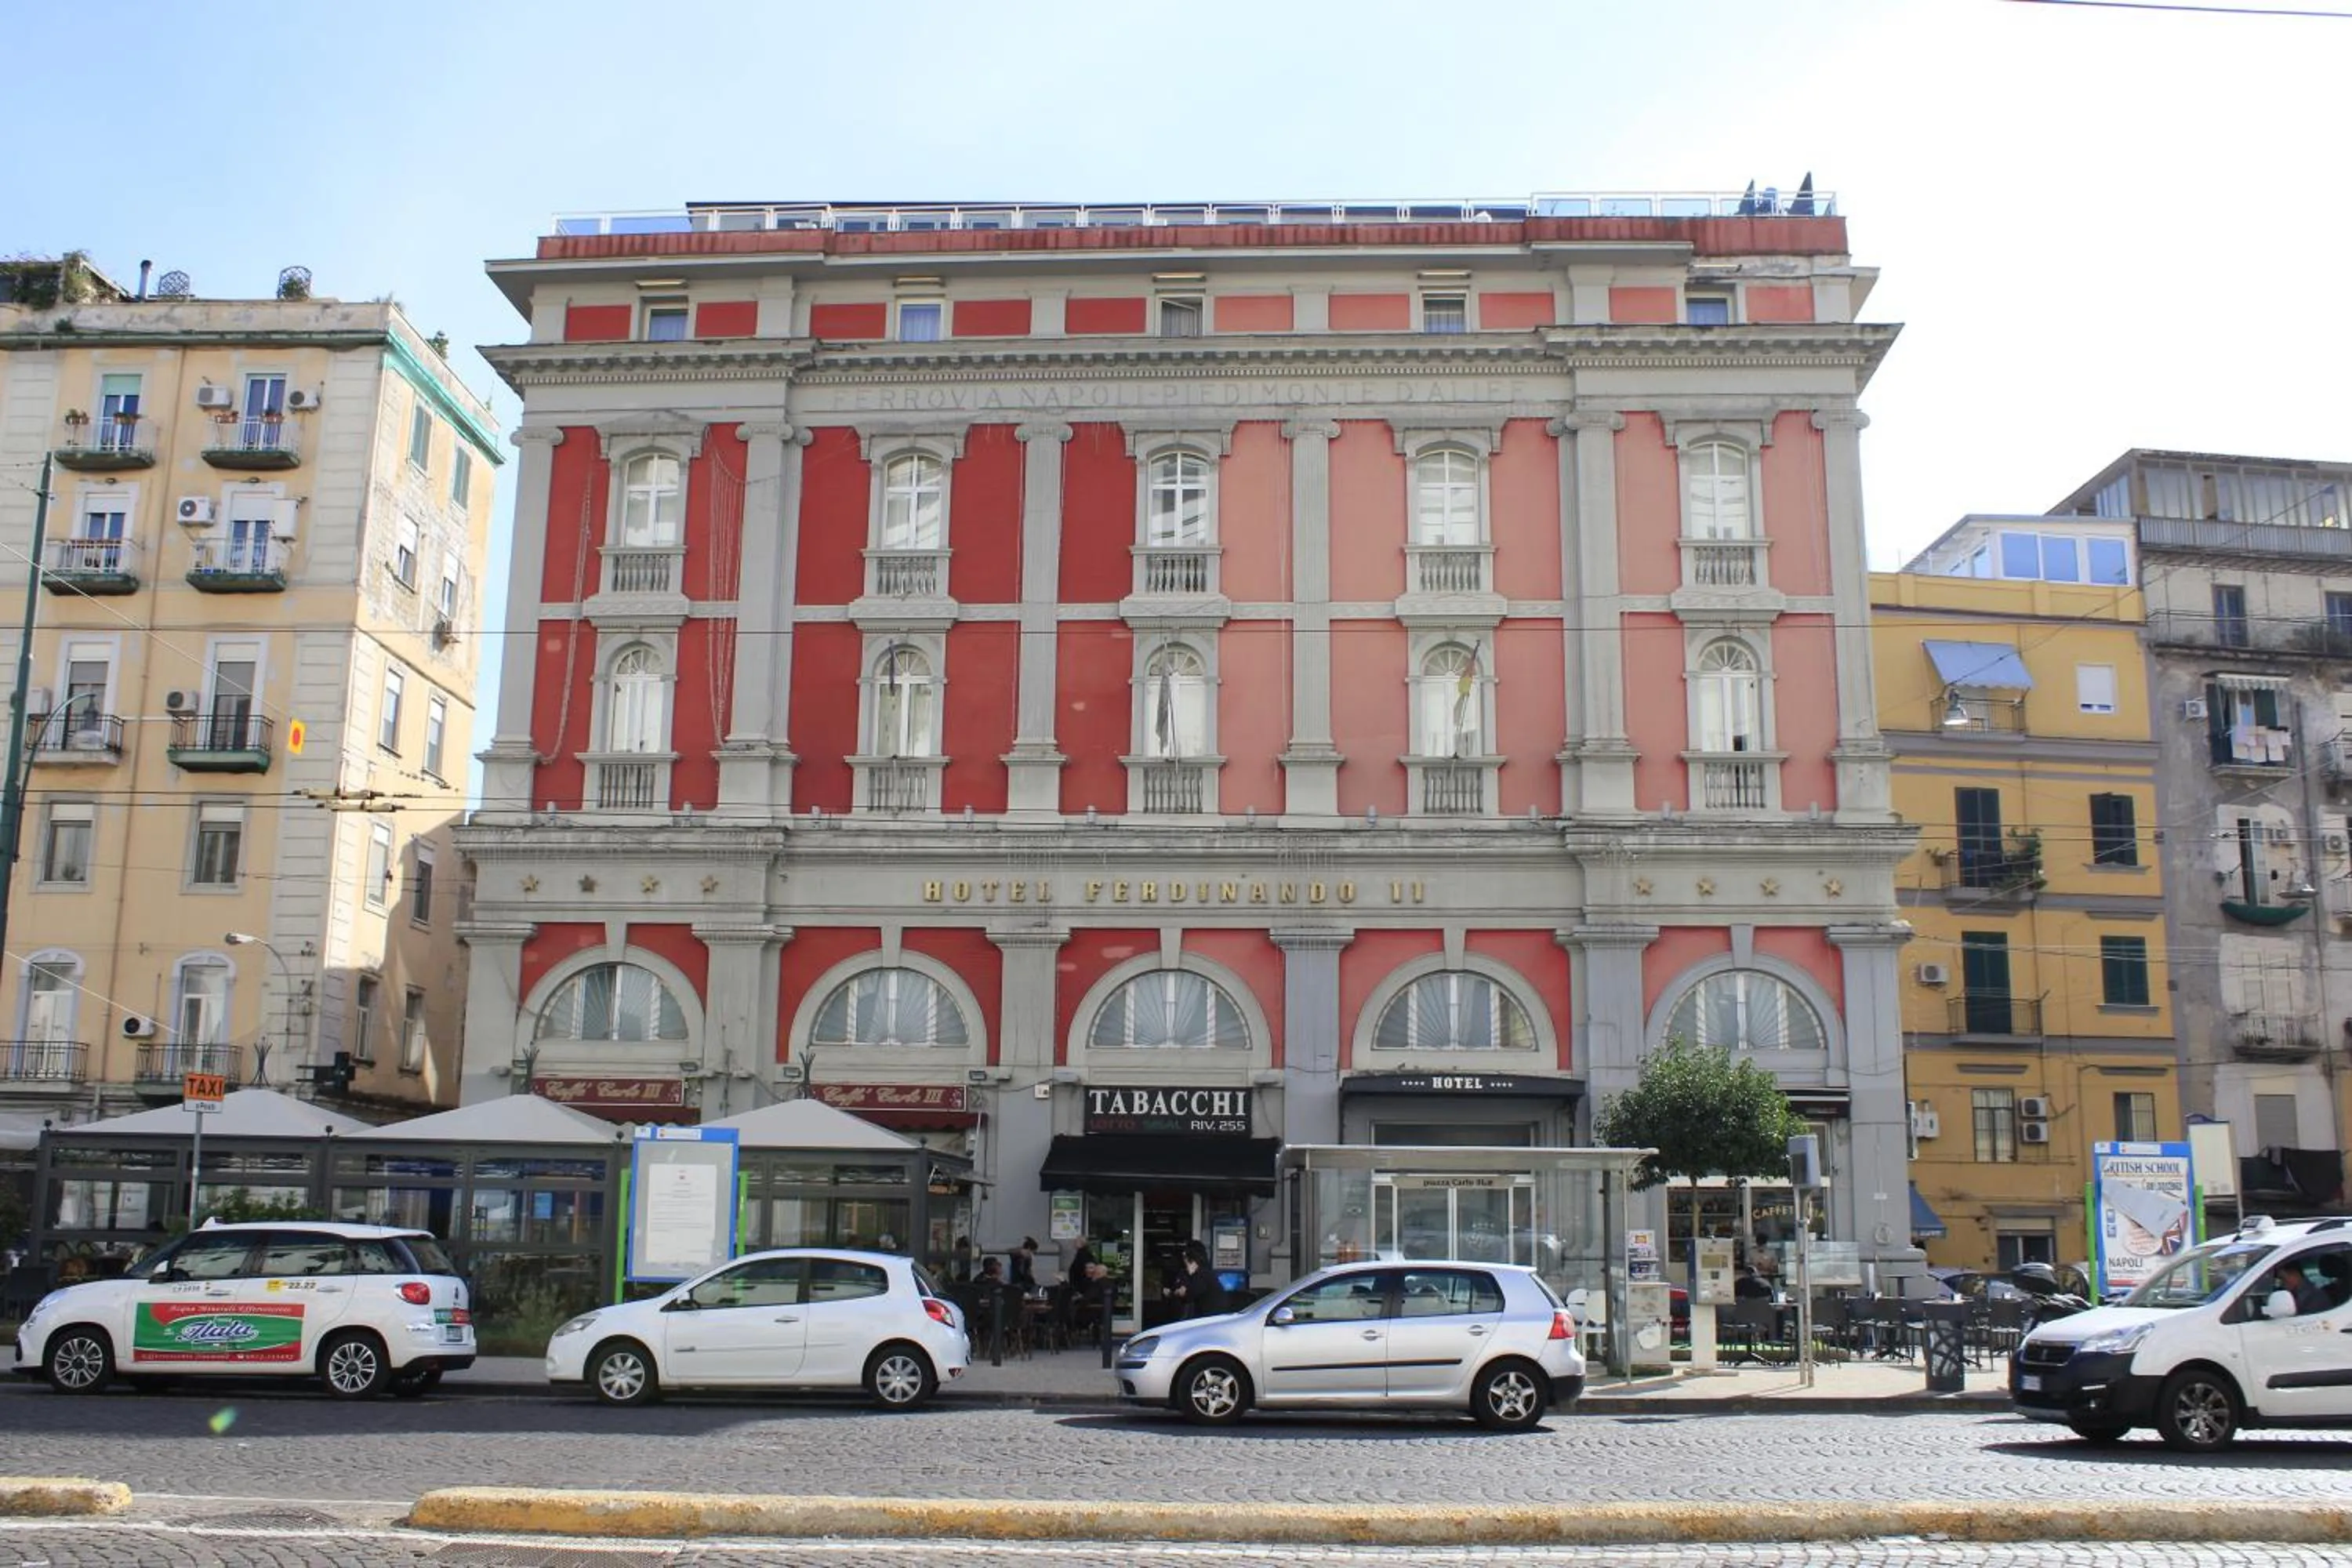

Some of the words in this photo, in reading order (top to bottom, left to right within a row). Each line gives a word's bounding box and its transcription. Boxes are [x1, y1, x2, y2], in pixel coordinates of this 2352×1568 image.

[832, 385, 1004, 409] FERROVIA
[923, 879, 1052, 902] HOTEL
[1084, 880, 1355, 904] FERDINANDO
[1386, 880, 1425, 903] II
[187, 1078, 223, 1097] TAXI
[597, 1081, 641, 1098] Carlo
[641, 1083, 664, 1098] III
[1432, 1076, 1483, 1089] HOTEL
[877, 1087, 920, 1103] Carlo
[922, 1088, 946, 1103] III
[1088, 1088, 1246, 1116] TABACCHI
[1090, 1119, 1135, 1130] LOTTO
[1190, 1120, 1216, 1131] RIV.
[1218, 1120, 1246, 1131] 255
[2144, 1162, 2180, 1174] SCHOOL
[2108, 1258, 2143, 1268] NAPOLI
